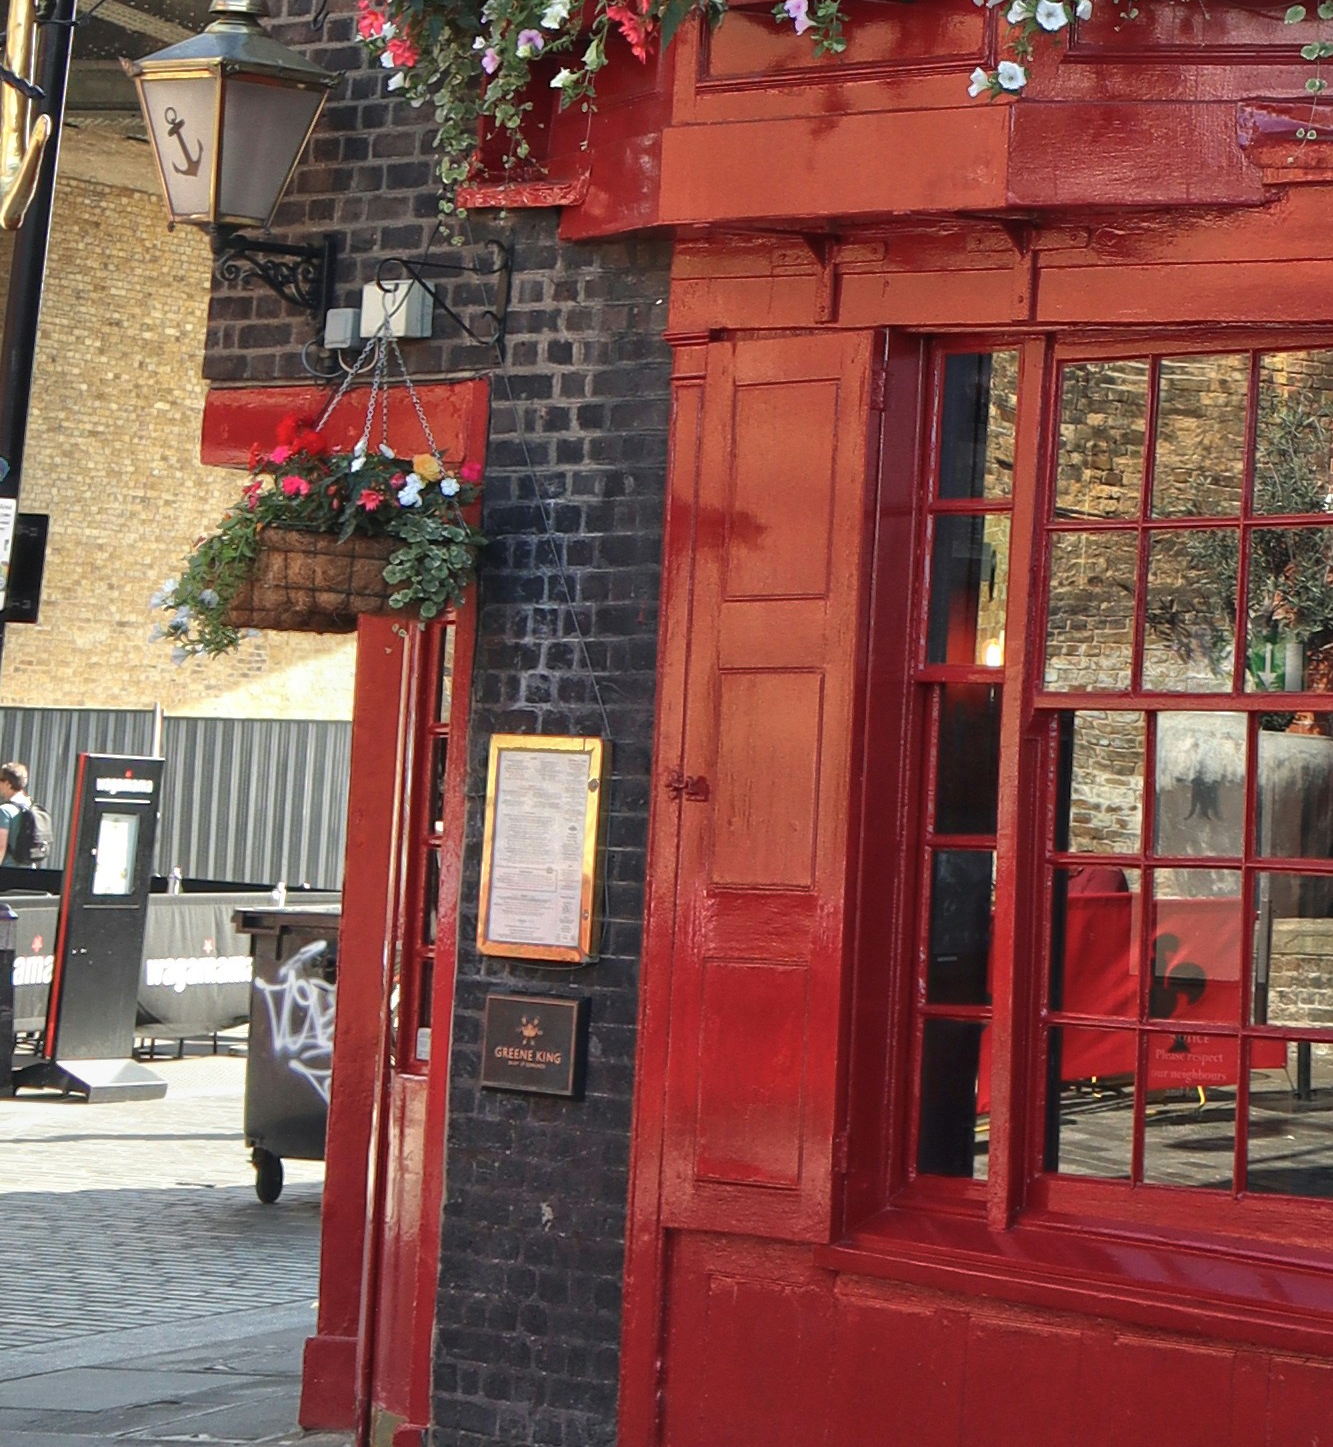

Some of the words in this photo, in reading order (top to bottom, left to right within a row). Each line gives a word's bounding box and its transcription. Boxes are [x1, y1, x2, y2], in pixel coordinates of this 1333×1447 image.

[494, 1045, 534, 1062] GREENE
[536, 1050, 562, 1065] KING
[1187, 1051, 1224, 1066] respect
[1171, 1068, 1227, 1084] neighbours
